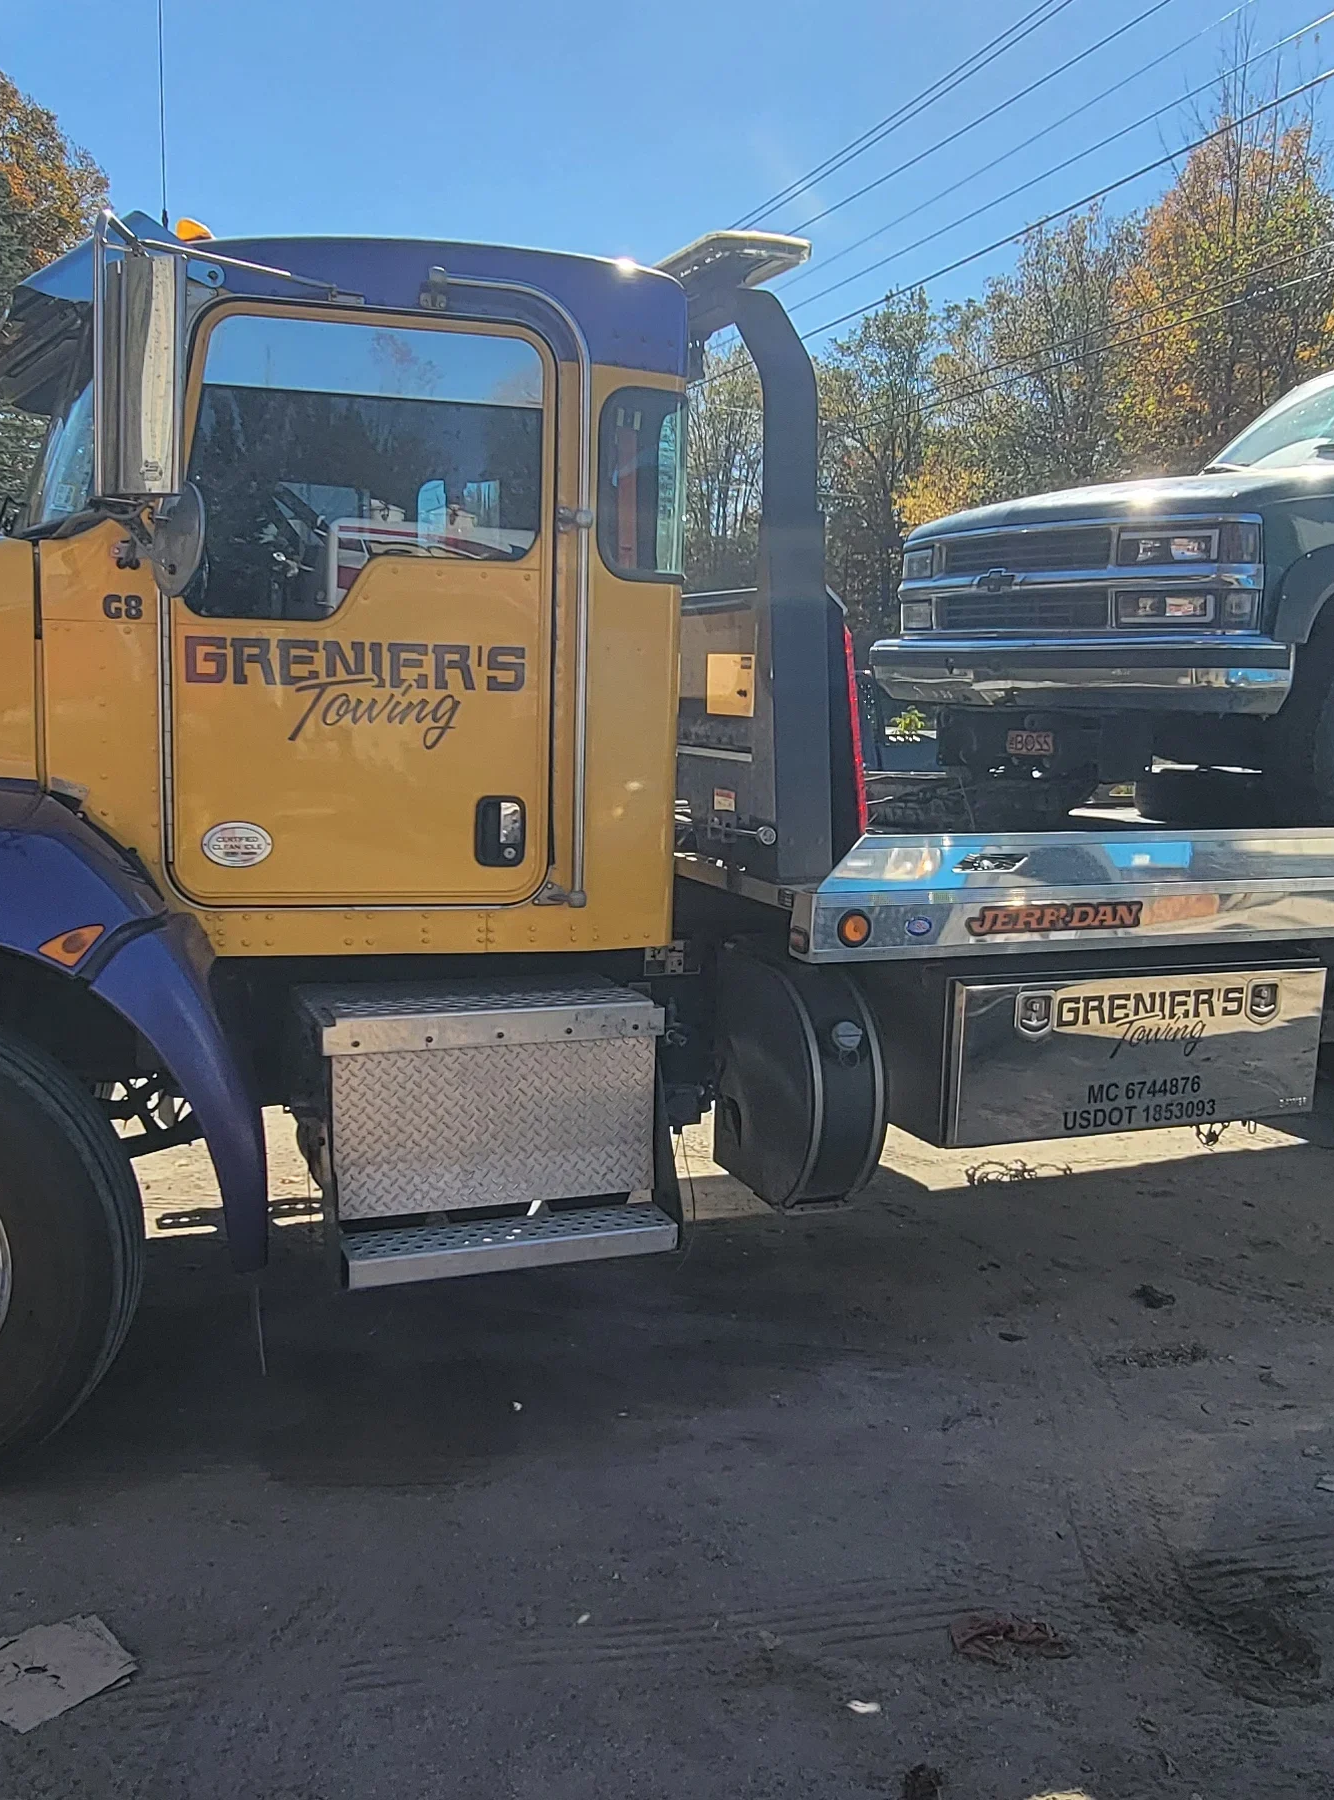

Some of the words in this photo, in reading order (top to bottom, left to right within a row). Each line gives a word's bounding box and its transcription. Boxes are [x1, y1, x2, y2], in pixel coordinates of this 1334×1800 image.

[103, 594, 143, 619] G8
[184, 635, 526, 692] GRENIER'S
[288, 675, 462, 750] Towing
[1015, 734, 1051, 751] BOSS
[1056, 986, 1244, 1028] GRENIER'S
[1109, 1013, 1206, 1058] Towing
[1087, 1083, 1119, 1104] MC
[1125, 1075, 1201, 1100] 6744876
[1063, 1105, 1137, 1131] USDOT
[1142, 1099, 1216, 1124] 1853093
